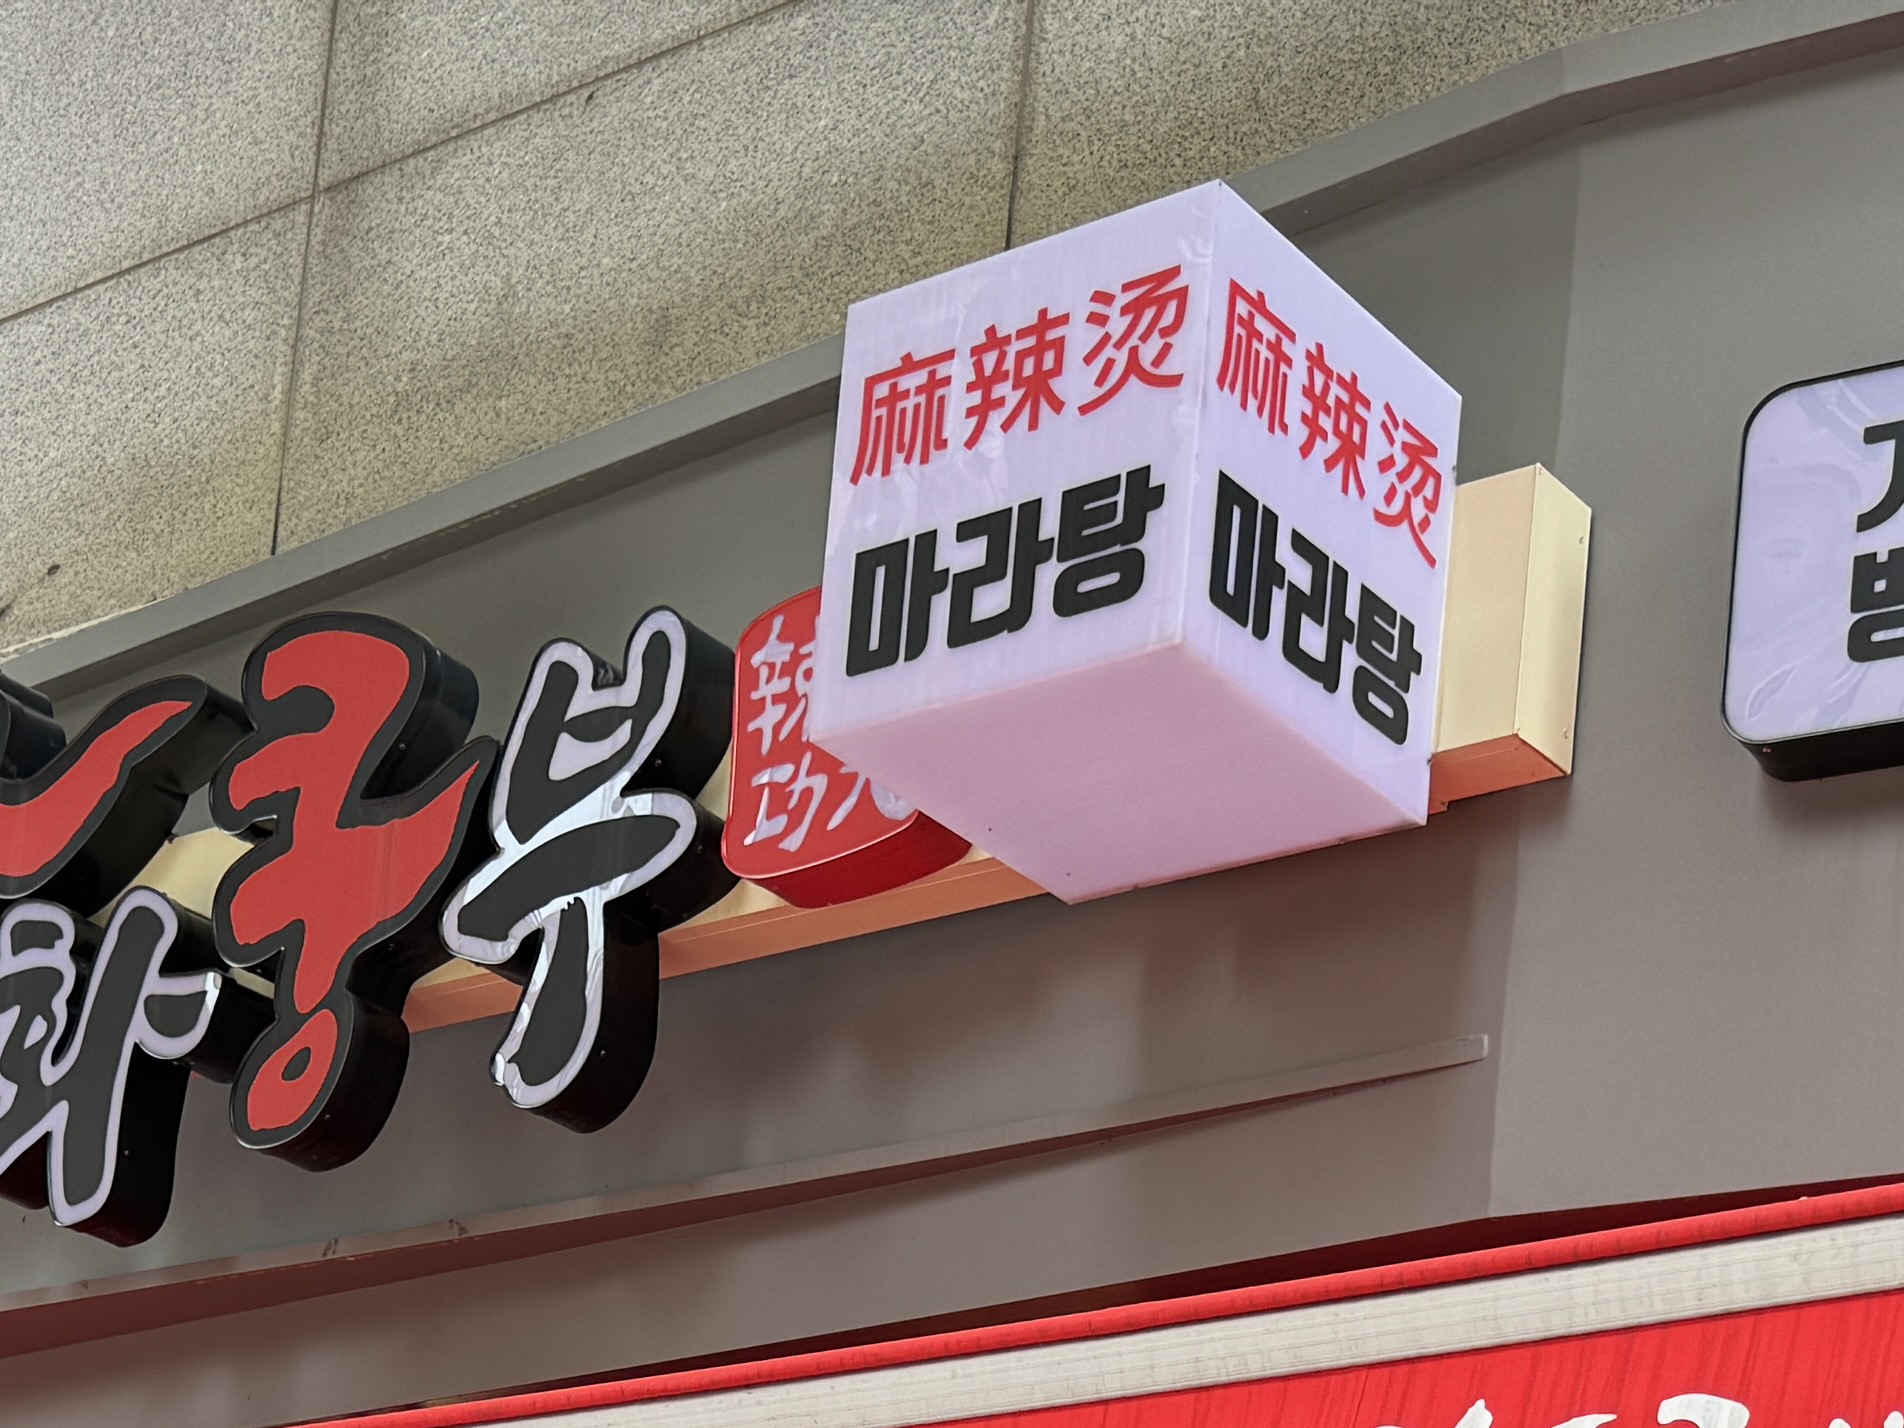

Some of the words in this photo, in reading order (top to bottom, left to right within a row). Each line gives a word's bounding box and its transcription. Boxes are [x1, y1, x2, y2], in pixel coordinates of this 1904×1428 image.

[851, 265, 1189, 486] 麻辣烫
[1217, 279, 1443, 568] 麻辣烫
[846, 465, 1165, 677] 마라탕
[1209, 469, 1422, 745] 마라탕
